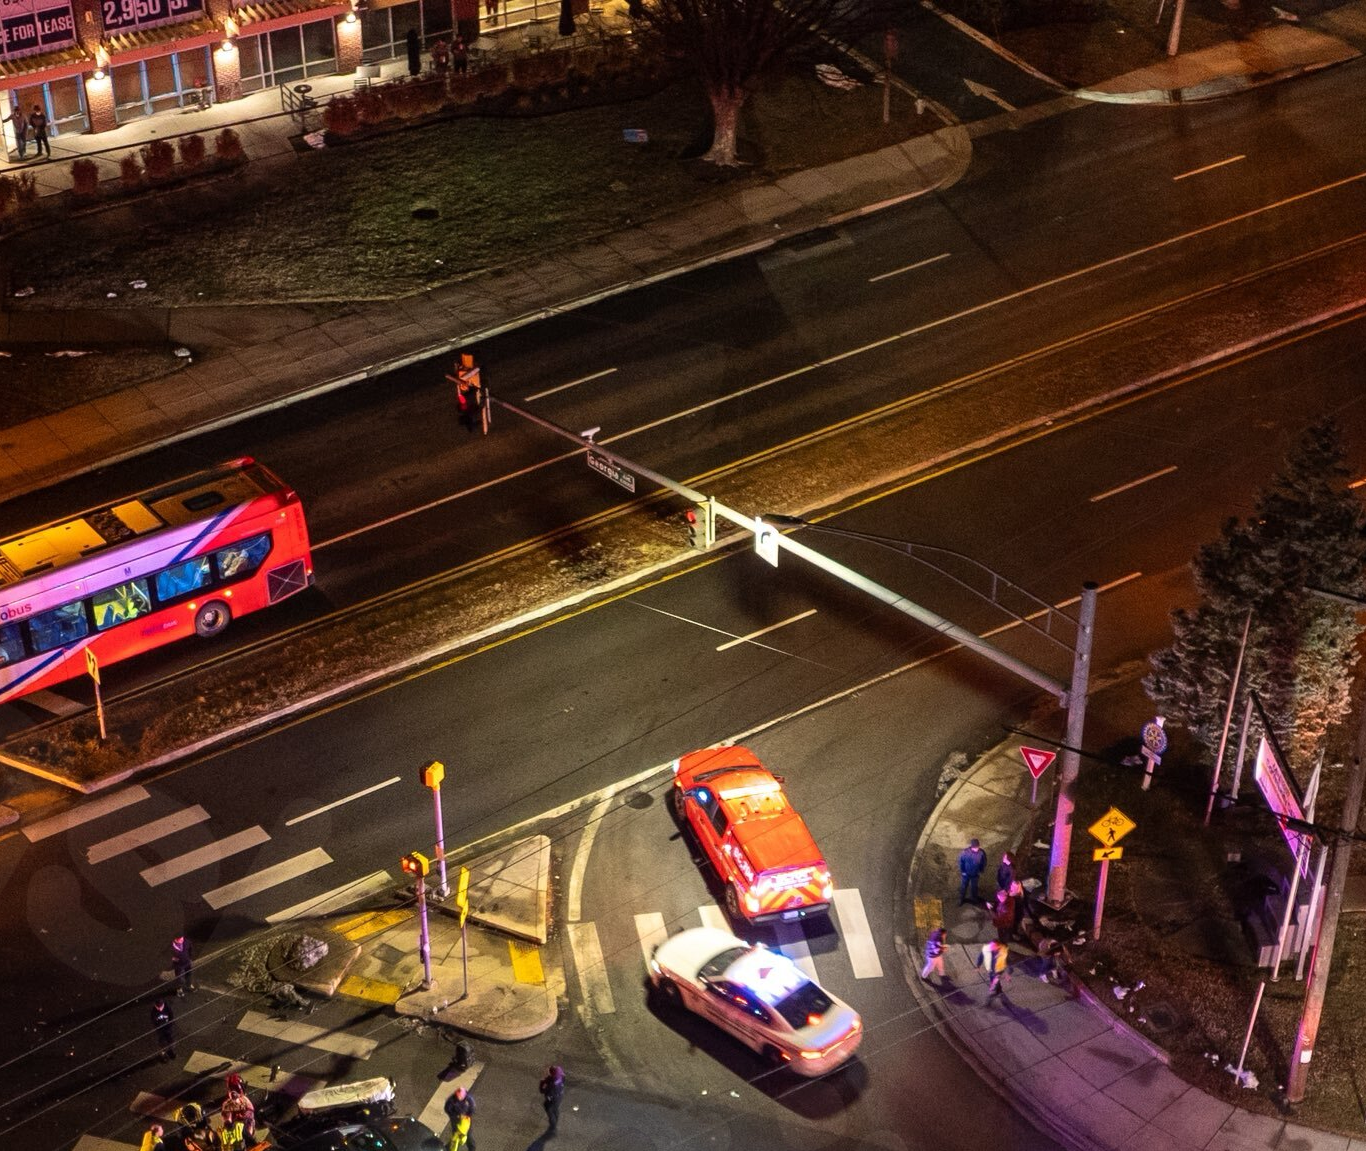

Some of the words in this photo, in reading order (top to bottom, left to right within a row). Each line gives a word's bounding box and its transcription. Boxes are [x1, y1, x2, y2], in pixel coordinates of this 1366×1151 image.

[13, 23, 36, 41] FOR
[38, 15, 73, 36] LEASE
[588, 455, 619, 480] Georgia
